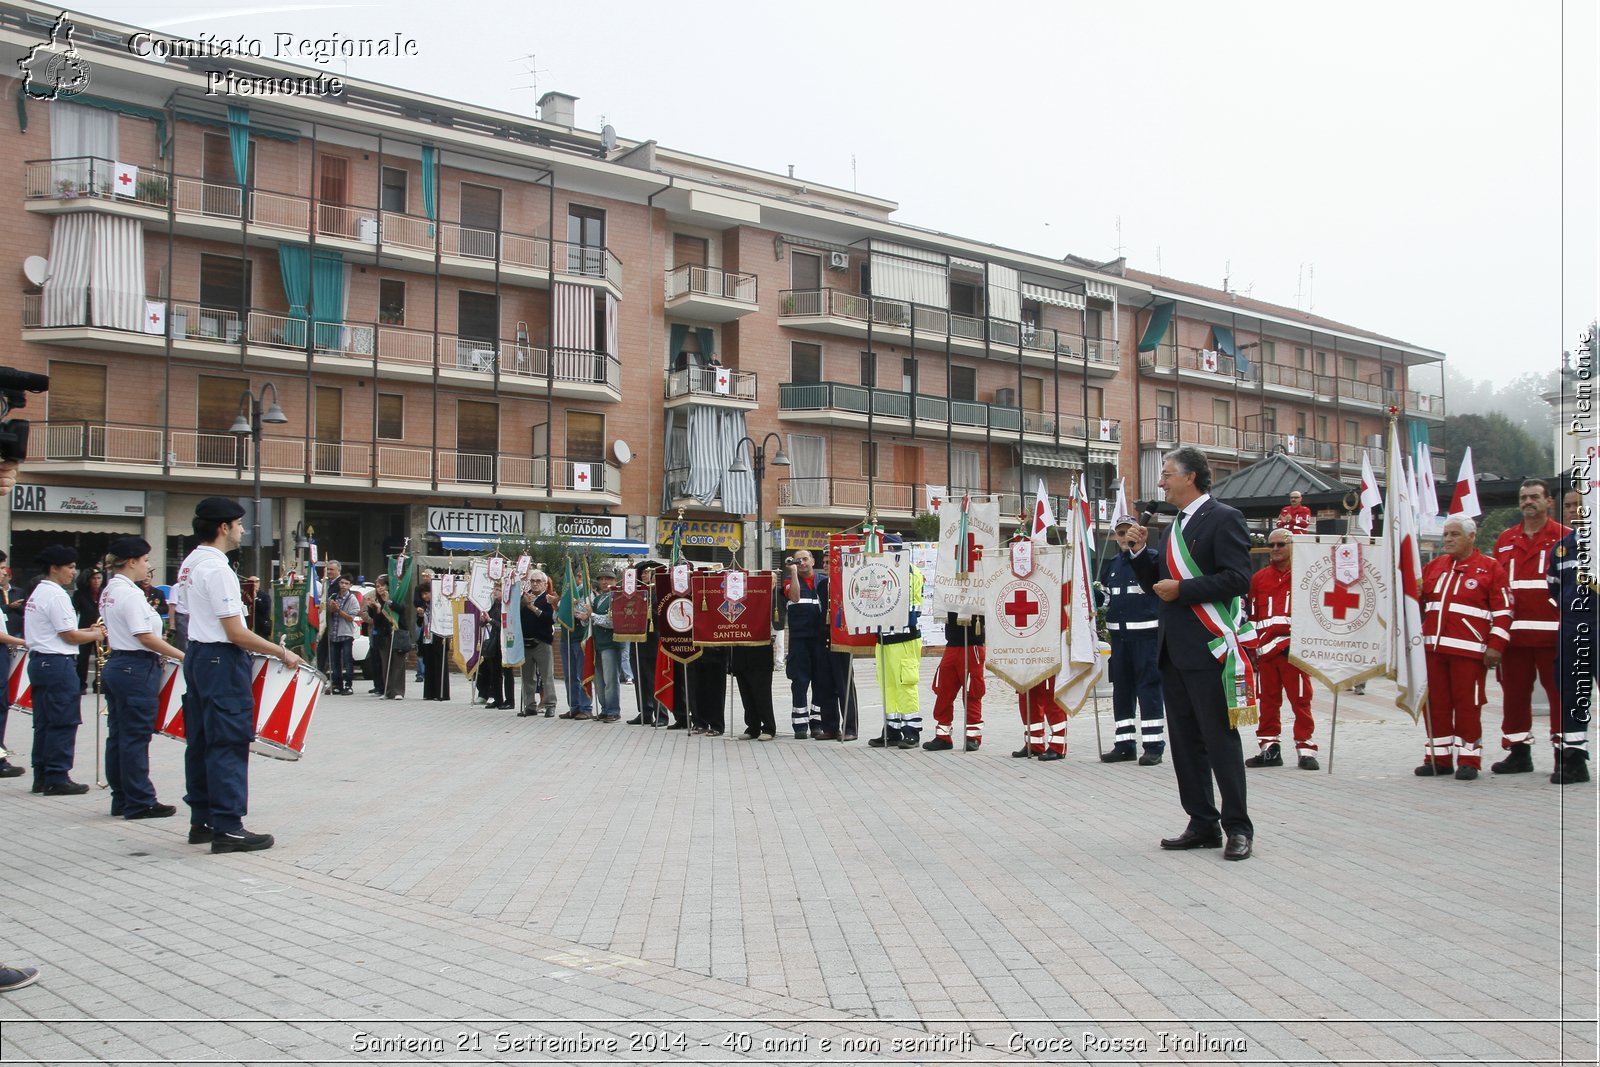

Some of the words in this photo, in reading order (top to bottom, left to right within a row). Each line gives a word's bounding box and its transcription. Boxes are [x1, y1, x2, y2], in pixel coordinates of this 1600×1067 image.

[14, 485, 47, 511] BAR
[60, 501, 98, 510] Paradise
[430, 510, 521, 533] CAFFETTERIA
[663, 521, 735, 533] TABACCHI
[557, 523, 610, 535] COSTADORO
[686, 535, 714, 544] LOTTO
[1300, 560, 1323, 591] CROCE
[1364, 587, 1375, 621] AGOSTO
[713, 631, 752, 639] SANTENA
[1301, 637, 1369, 649] SOTTOCOMITATO
[1301, 649, 1378, 665] CARMAGNOLA
